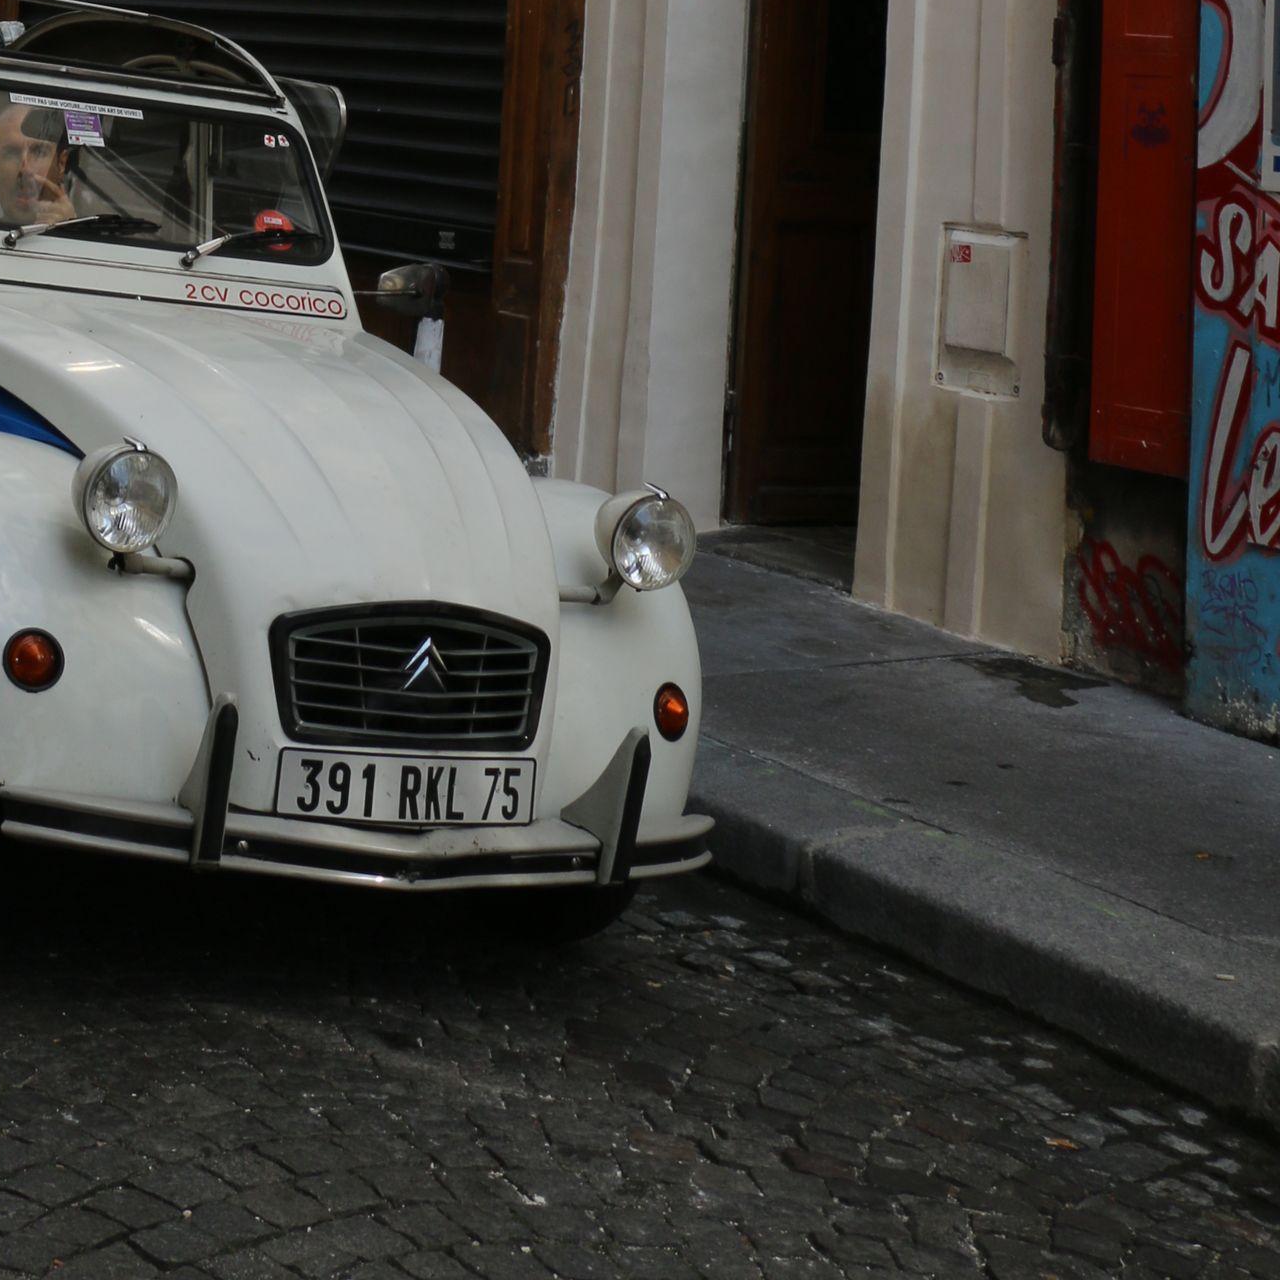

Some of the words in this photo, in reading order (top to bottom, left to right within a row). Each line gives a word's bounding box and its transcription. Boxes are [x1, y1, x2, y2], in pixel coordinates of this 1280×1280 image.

[296, 757, 376, 818] 391
[399, 765, 464, 820] RKL
[482, 767, 522, 821] 75
